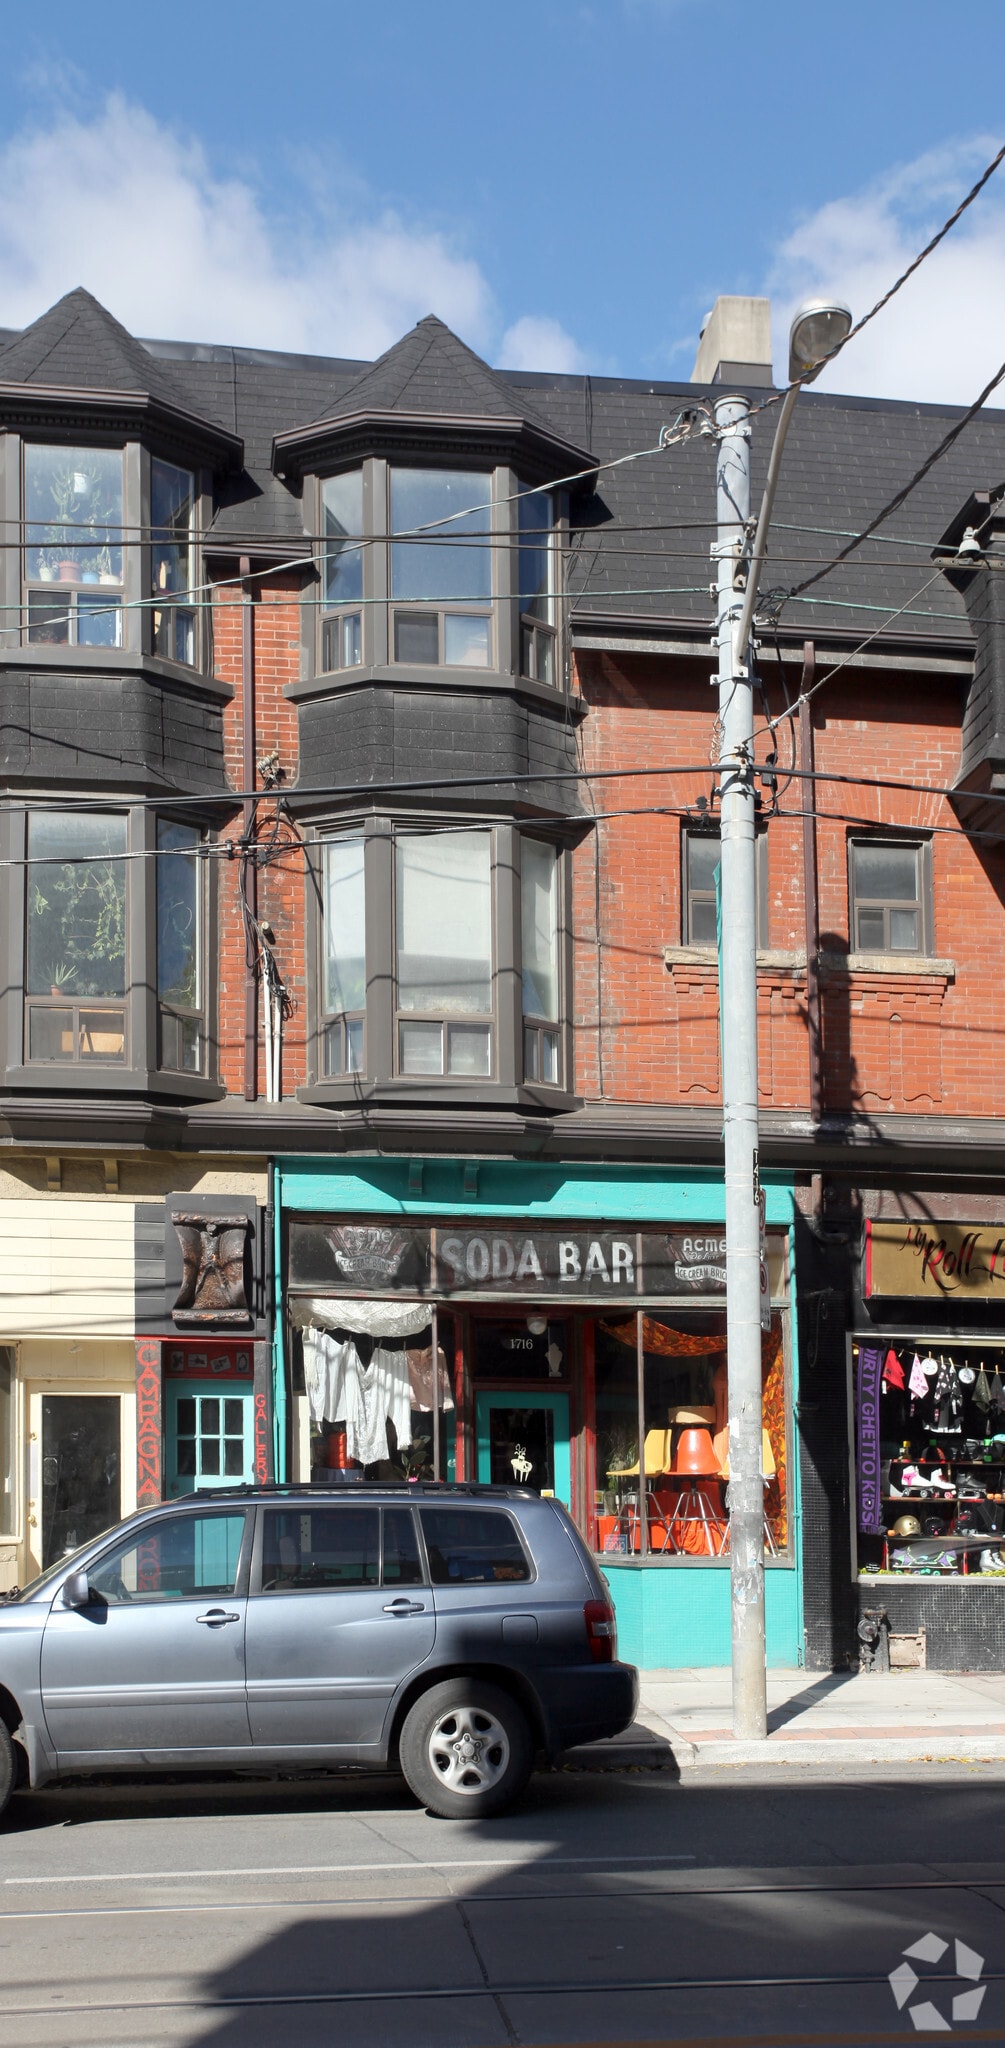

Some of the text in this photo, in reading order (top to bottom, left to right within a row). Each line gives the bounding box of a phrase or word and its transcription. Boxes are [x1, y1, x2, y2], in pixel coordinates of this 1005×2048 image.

[441, 1237, 635, 1283] SODA BAR
[676, 1267, 687, 1279] ICE
[898, 1227, 927, 1256] My
[922, 1232, 983, 1292] Roll
[511, 1338, 534, 1350] 1716
[137, 1345, 161, 1498] CAMPAGNA
[254, 1394, 268, 1485] GALLERY
[862, 1402, 876, 1475] GHETTO
